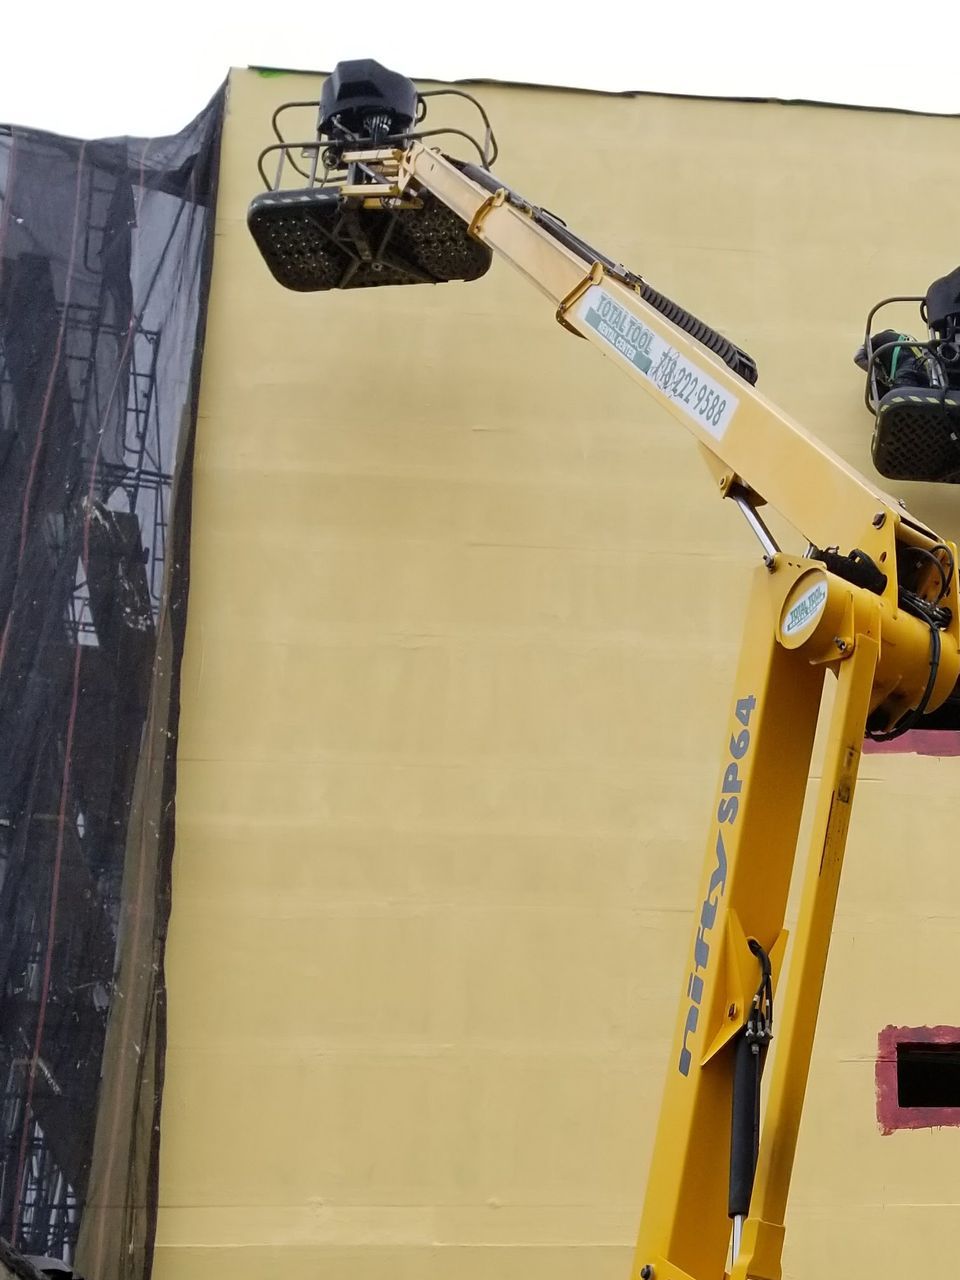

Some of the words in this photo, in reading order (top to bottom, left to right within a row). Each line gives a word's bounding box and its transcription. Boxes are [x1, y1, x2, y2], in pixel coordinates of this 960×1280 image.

[596, 291, 627, 337] TOTAL
[625, 316, 656, 358] TOOL
[615, 336, 637, 361] CENTER
[678, 829, 728, 1077] nifty
[718, 695, 757, 825] SP64
